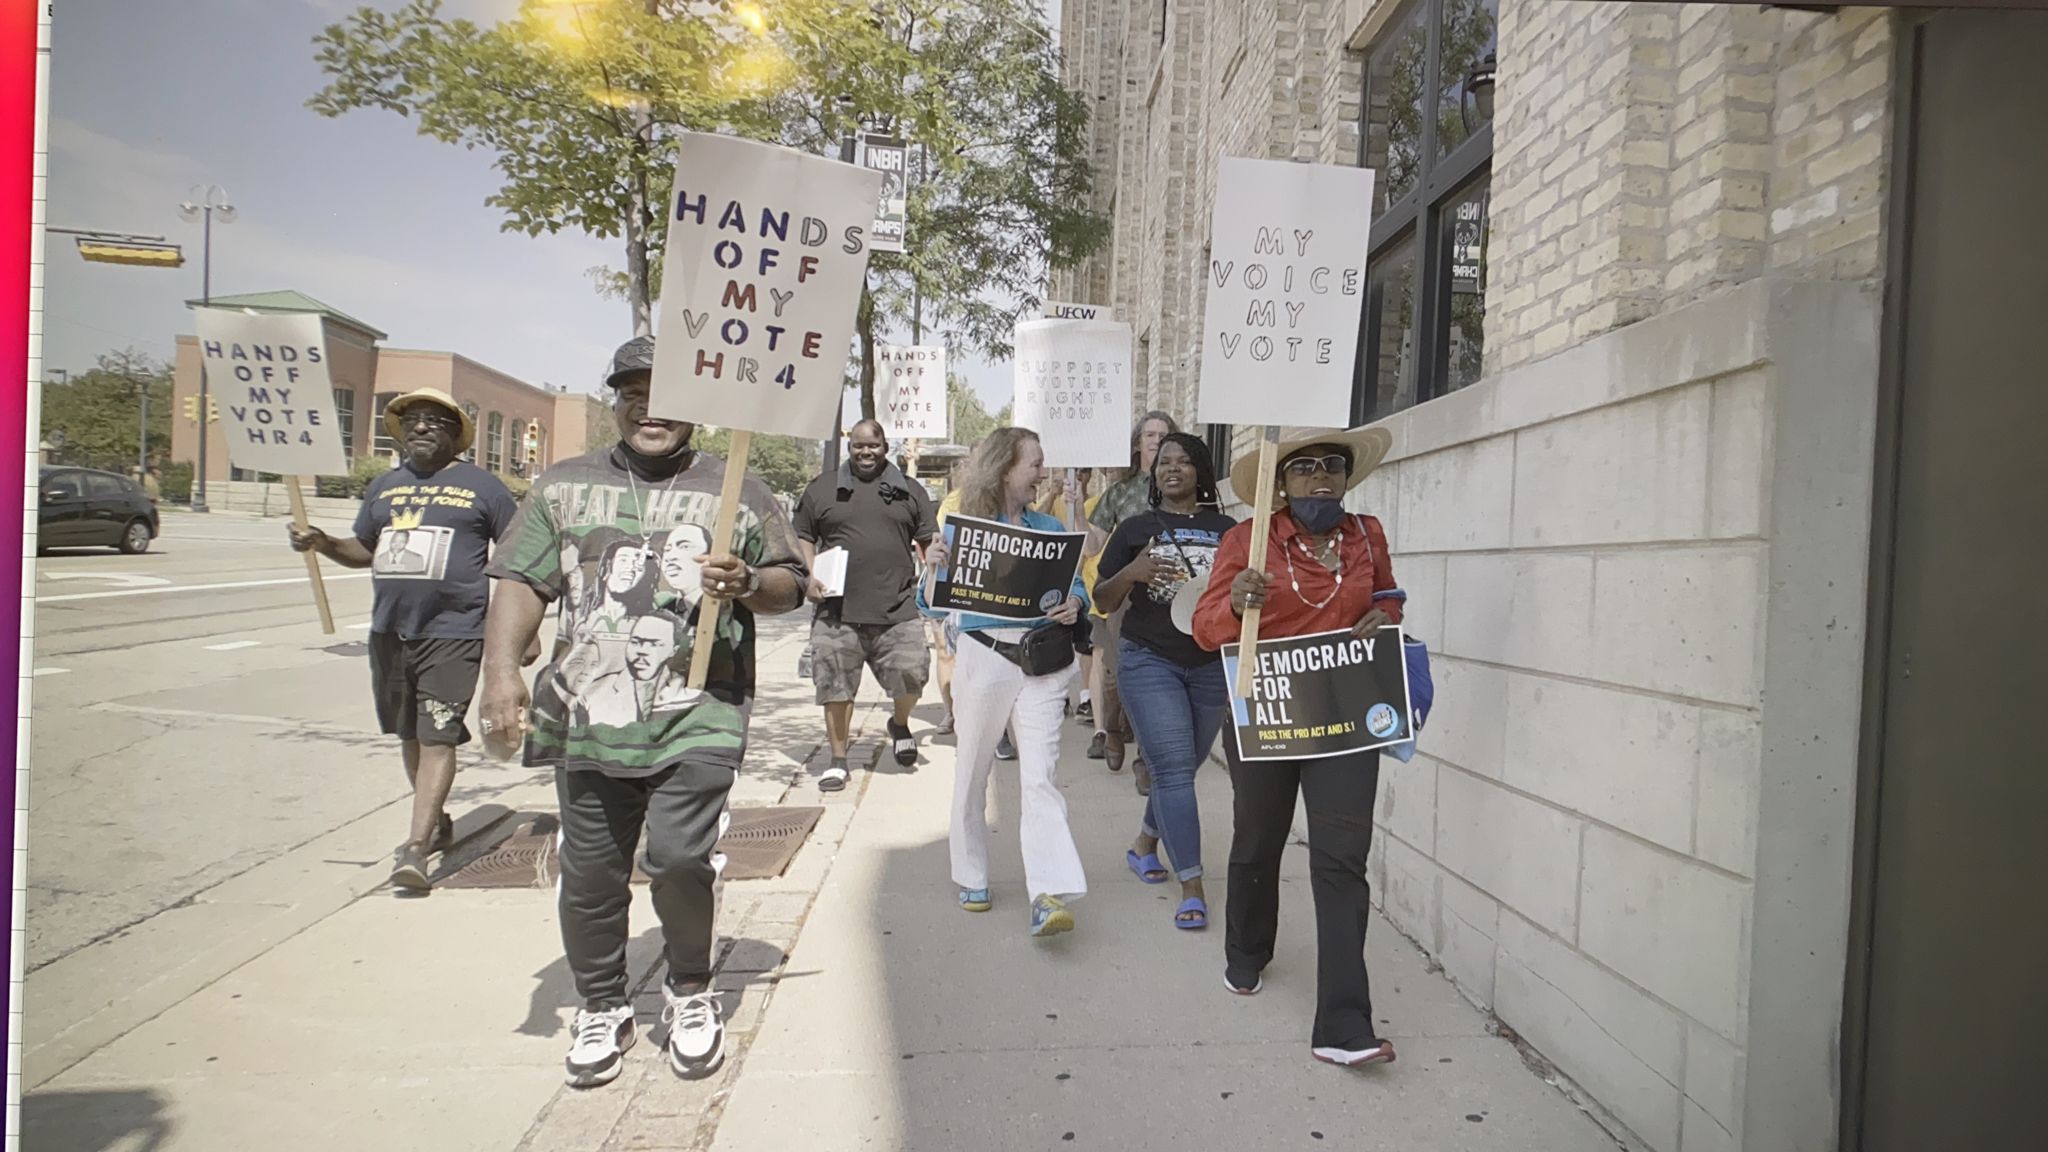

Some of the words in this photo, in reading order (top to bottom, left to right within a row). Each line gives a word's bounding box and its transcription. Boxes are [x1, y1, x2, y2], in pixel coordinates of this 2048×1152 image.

[675, 190, 863, 254] HANDS
[871, 220, 901, 235] AMPS
[1254, 226, 1313, 256] MY
[714, 240, 818, 283] OFF
[1213, 259, 1358, 295] VOICE
[721, 280, 793, 317] MY
[1055, 306, 1096, 320] UFCW
[1246, 299, 1305, 328] MY
[683, 309, 822, 358] VOTE
[204, 340, 321, 362] HANDS
[881, 351, 937, 362] HANDS
[1220, 332, 1332, 364] VOTE
[234, 365, 300, 383] OFF
[894, 367, 925, 377] OFF
[1021, 360, 1122, 374] SUPPORT
[899, 386, 920, 396] MY
[1036, 376, 1107, 389] VOTER
[249, 387, 291, 404] MY
[1027, 391, 1112, 404] RIGHTS
[230, 405, 321, 425] VOTE
[889, 402, 932, 412] VOTE
[1050, 406, 1094, 420] NOW
[959, 526, 1067, 560] DEMOCRACY
[957, 546, 992, 570] FOR
[952, 566, 984, 588] ALL
[950, 587, 967, 597] PASS
[968, 589, 980, 600] THE
[994, 594, 1008, 604] ACT
[1008, 596, 1020, 606] AND
[1252, 676, 1292, 700] FOR
[1256, 701, 1293, 726] ALL
[1258, 730, 1277, 740] PASS
[1278, 728, 1292, 740] THE
[1294, 728, 1309, 738] PRO
[1311, 726, 1325, 737] ACT
[1328, 724, 1342, 735] AND
